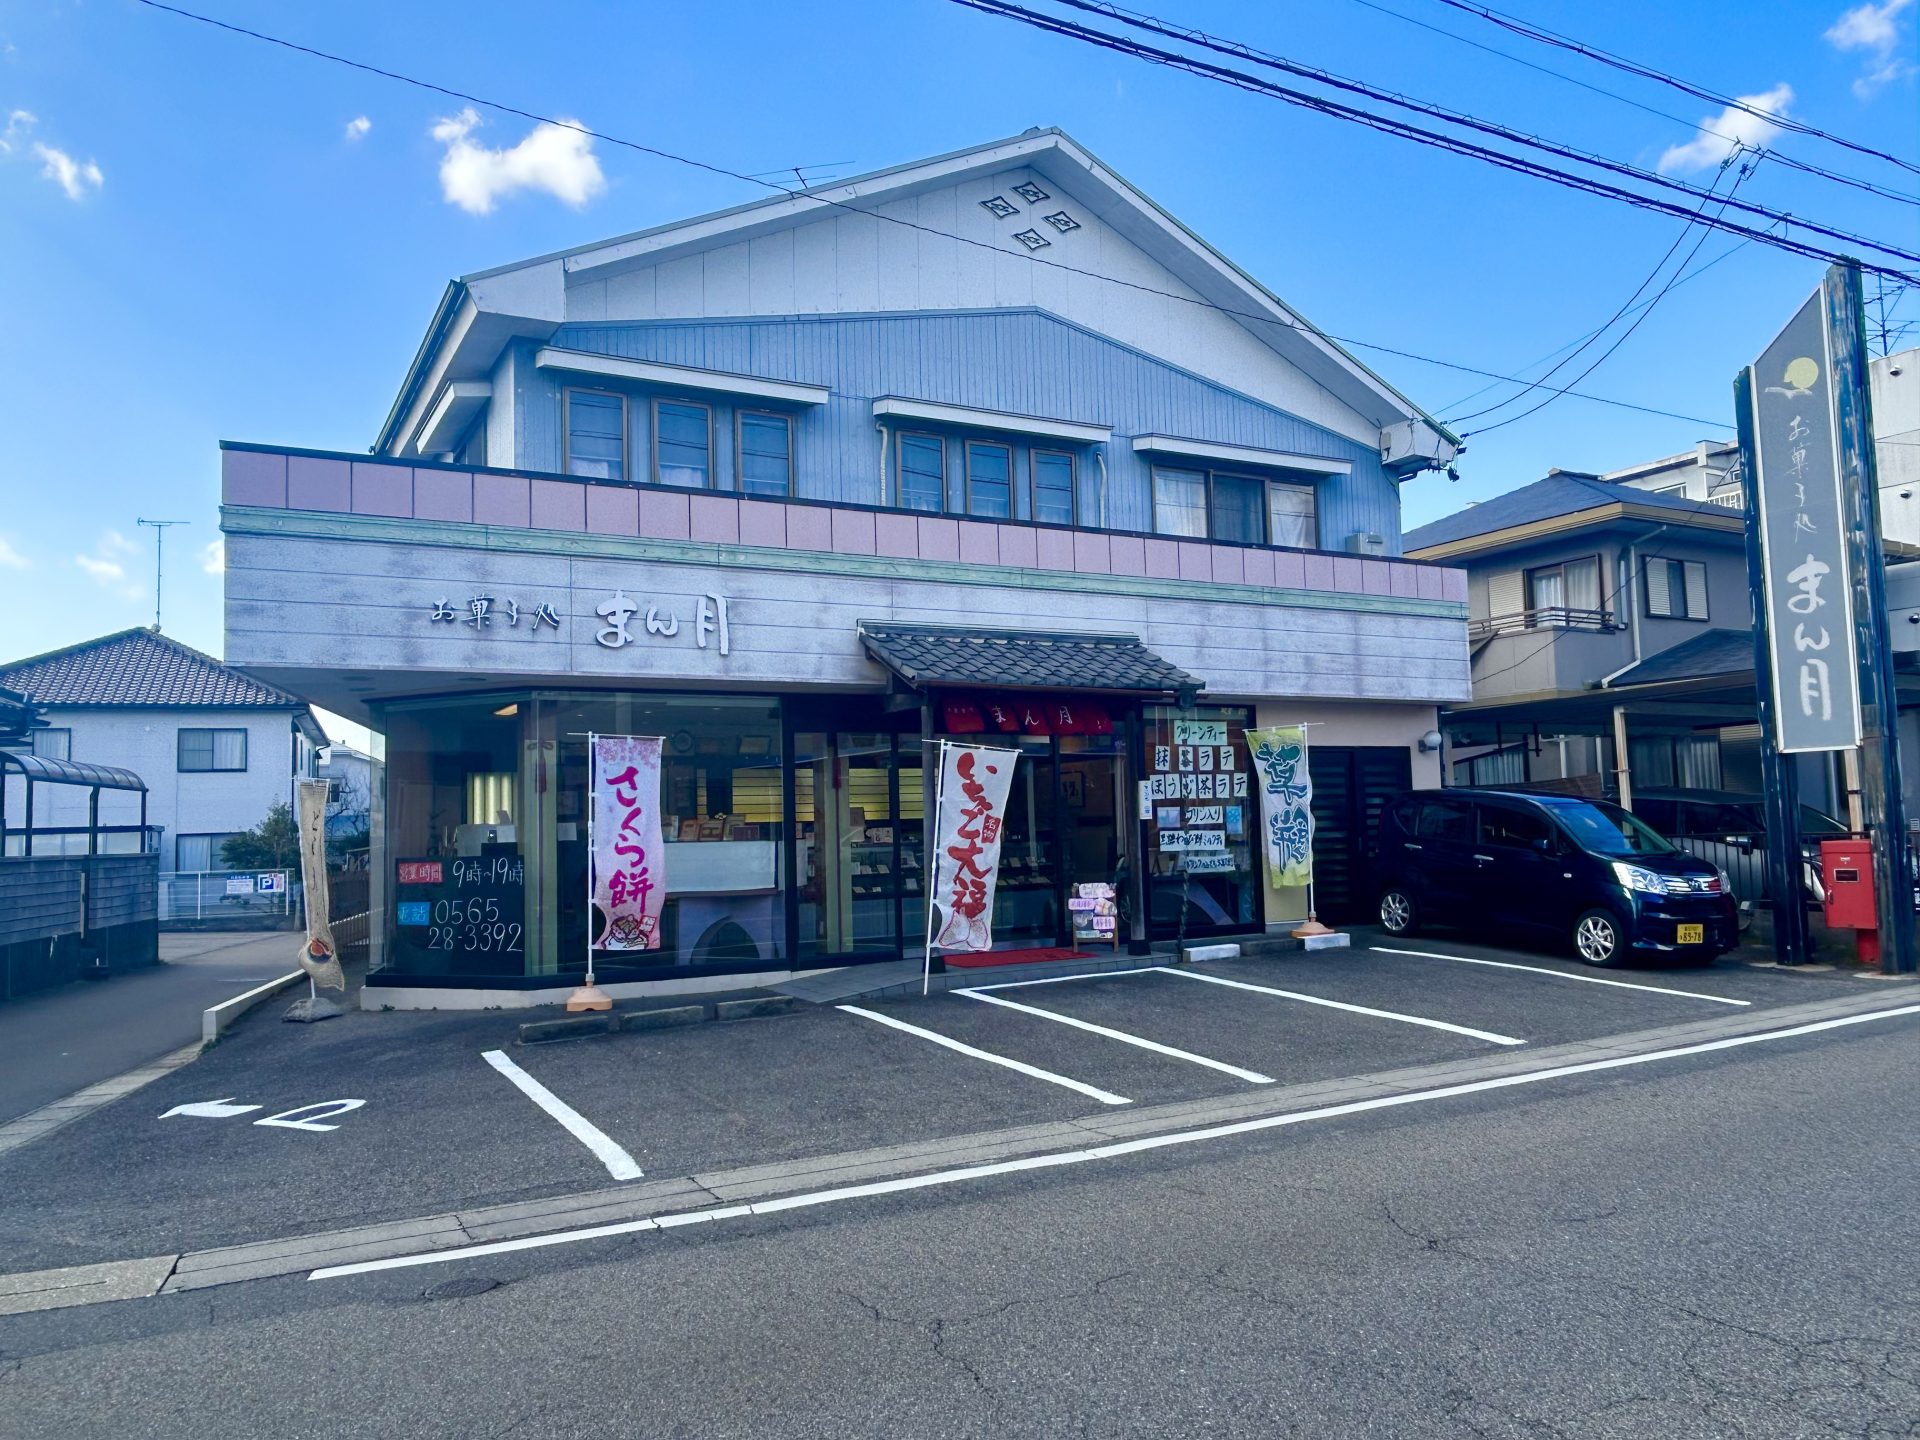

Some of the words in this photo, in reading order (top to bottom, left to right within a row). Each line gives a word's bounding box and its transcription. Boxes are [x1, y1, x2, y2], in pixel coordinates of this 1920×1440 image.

[1784, 415, 1817, 544] お菓子処
[432, 593, 560, 630] お菓子処
[595, 590, 729, 656] まん月
[1786, 554, 1831, 721] まん月
[992, 705, 1072, 725] まん月
[606, 766, 654, 914] さくら餅
[947, 752, 997, 919] いちご大福
[428, 923, 522, 952] 28-3392
[435, 897, 499, 924] 0565
